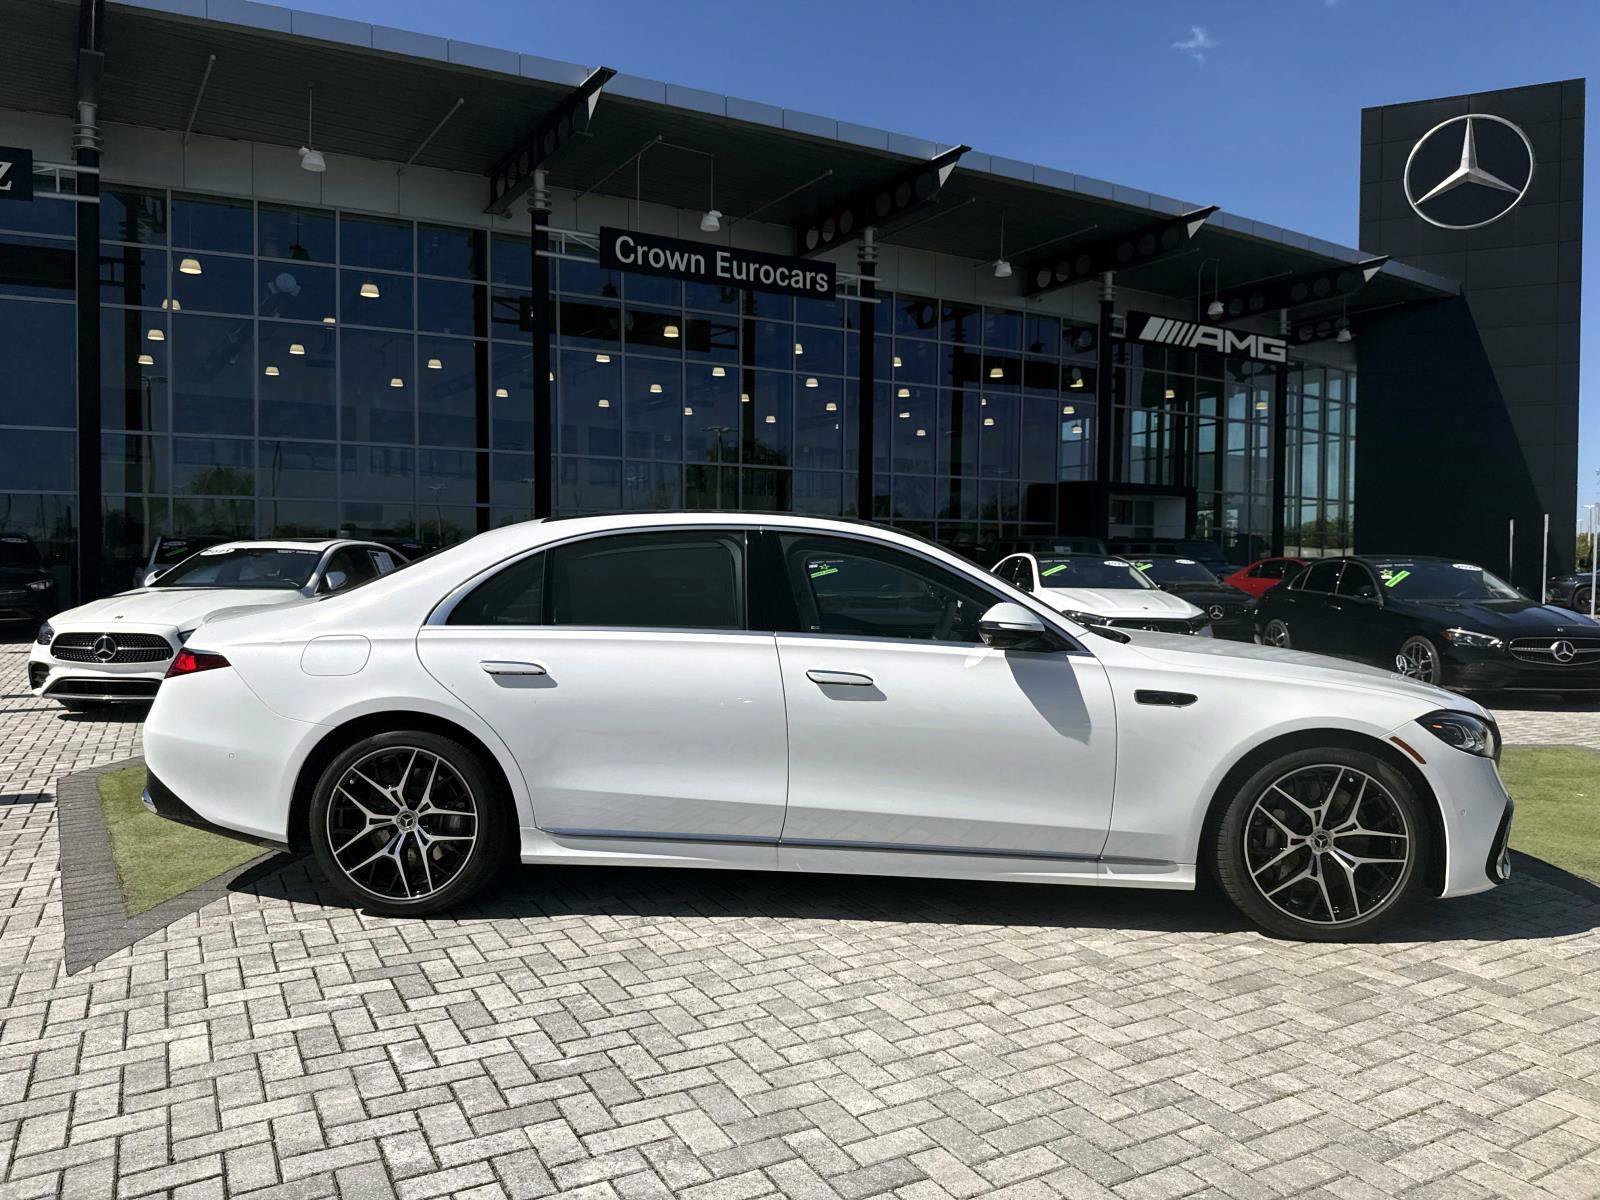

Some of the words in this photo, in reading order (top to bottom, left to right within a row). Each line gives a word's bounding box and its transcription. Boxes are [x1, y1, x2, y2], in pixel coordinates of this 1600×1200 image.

[615, 235, 706, 276] Crown
[716, 251, 828, 292] Eurocars
[1188, 325, 1286, 363] AMG
